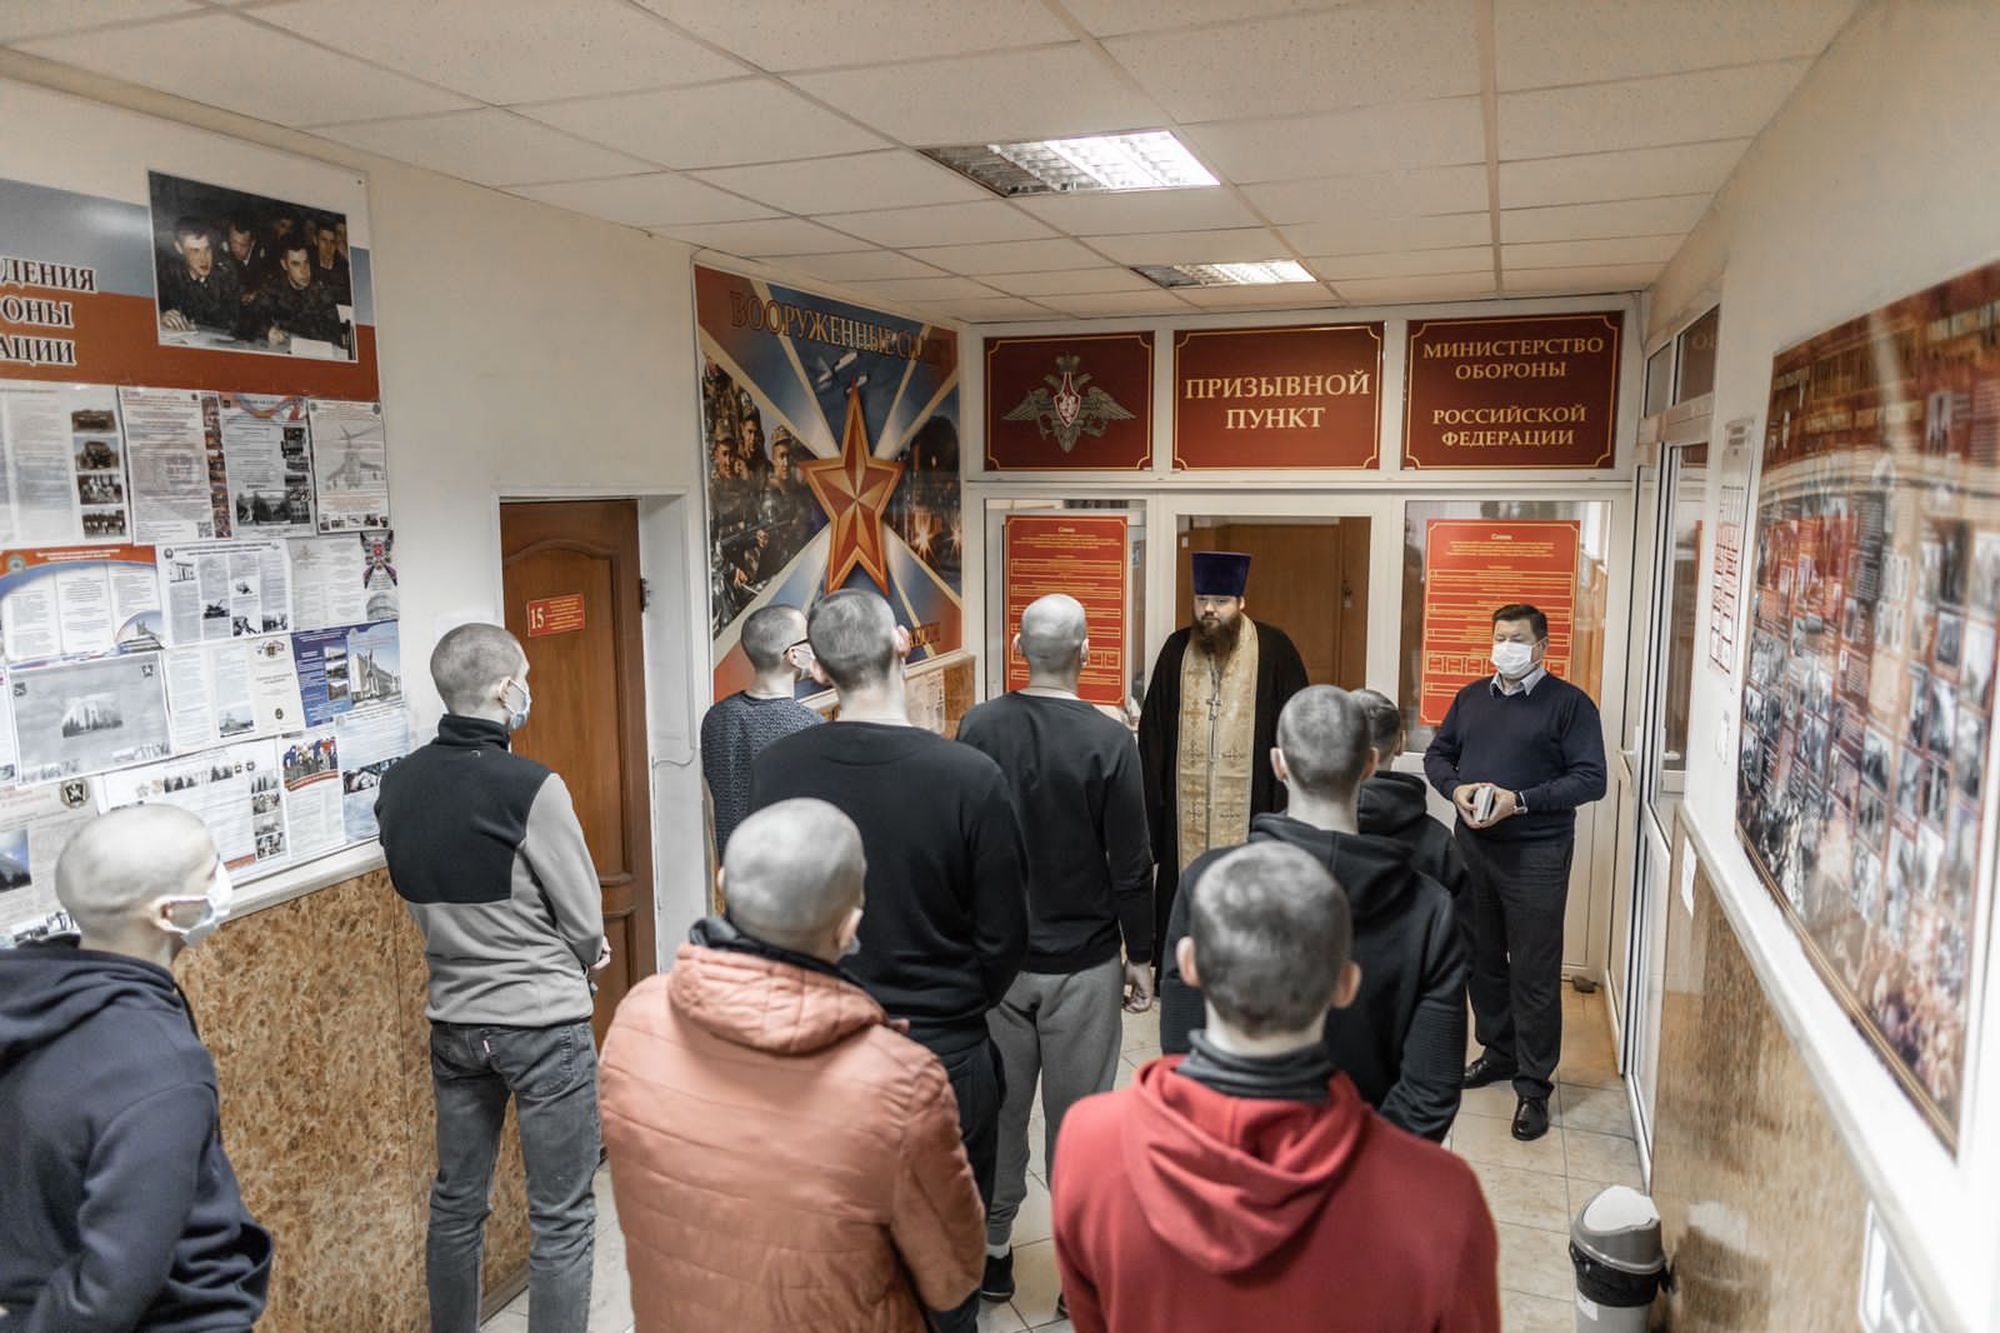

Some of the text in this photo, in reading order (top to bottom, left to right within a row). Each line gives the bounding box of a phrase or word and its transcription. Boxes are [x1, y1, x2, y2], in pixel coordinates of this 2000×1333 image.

[1, 296, 73, 327] ОНЫ
[729, 290, 896, 355] ВООРУЖЕННЫЕ
[1423, 337, 1604, 359] МИНИСТЕРСТВО
[1455, 362, 1567, 380] ОБОРОНЫ
[1185, 369, 1371, 399] ПРИЗЫВНОЙ
[1226, 407, 1326, 429] ПУНКТ
[1432, 404, 1588, 425] РОССИЙСКОЙ
[1441, 429, 1575, 448] ФЕДЕРАЦИИ
[530, 606, 545, 630] 15
